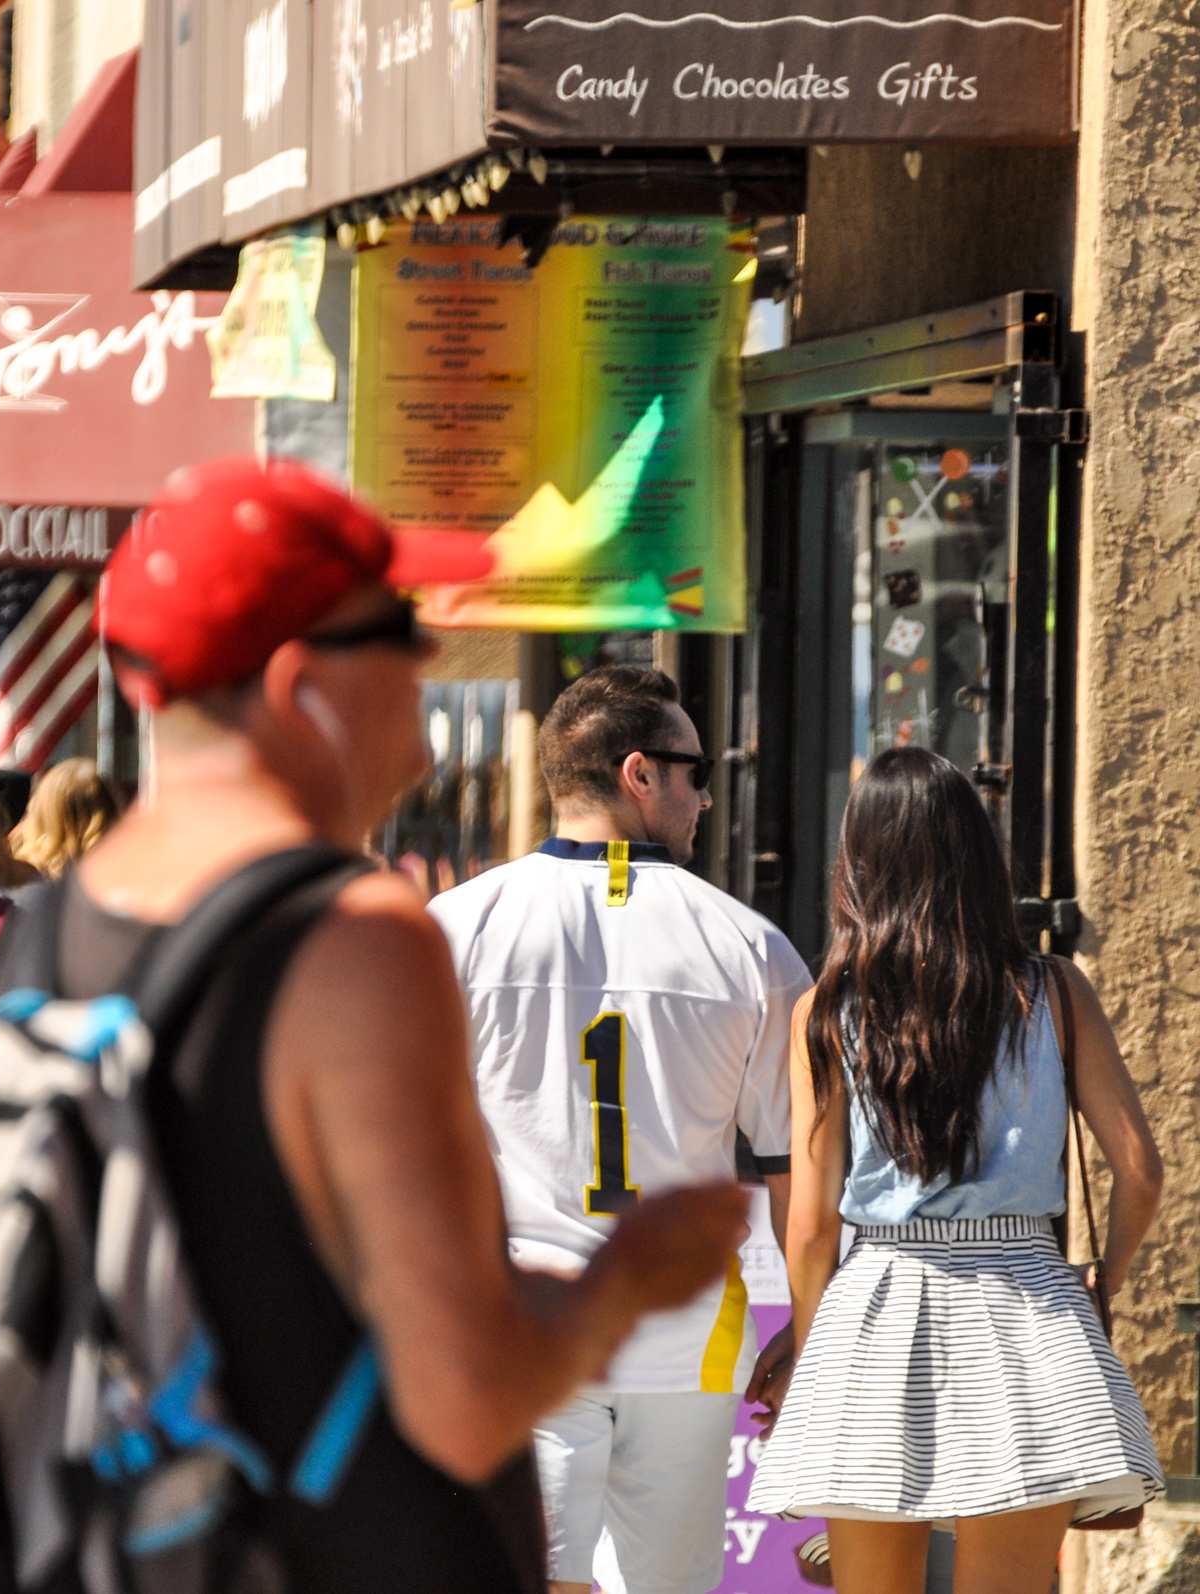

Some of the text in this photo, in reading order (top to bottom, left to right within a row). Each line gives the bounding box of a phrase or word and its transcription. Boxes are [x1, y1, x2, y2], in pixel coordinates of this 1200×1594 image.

[556, 62, 978, 116] Candy Chocolates Gifts
[580, 1012, 642, 1217] 1
